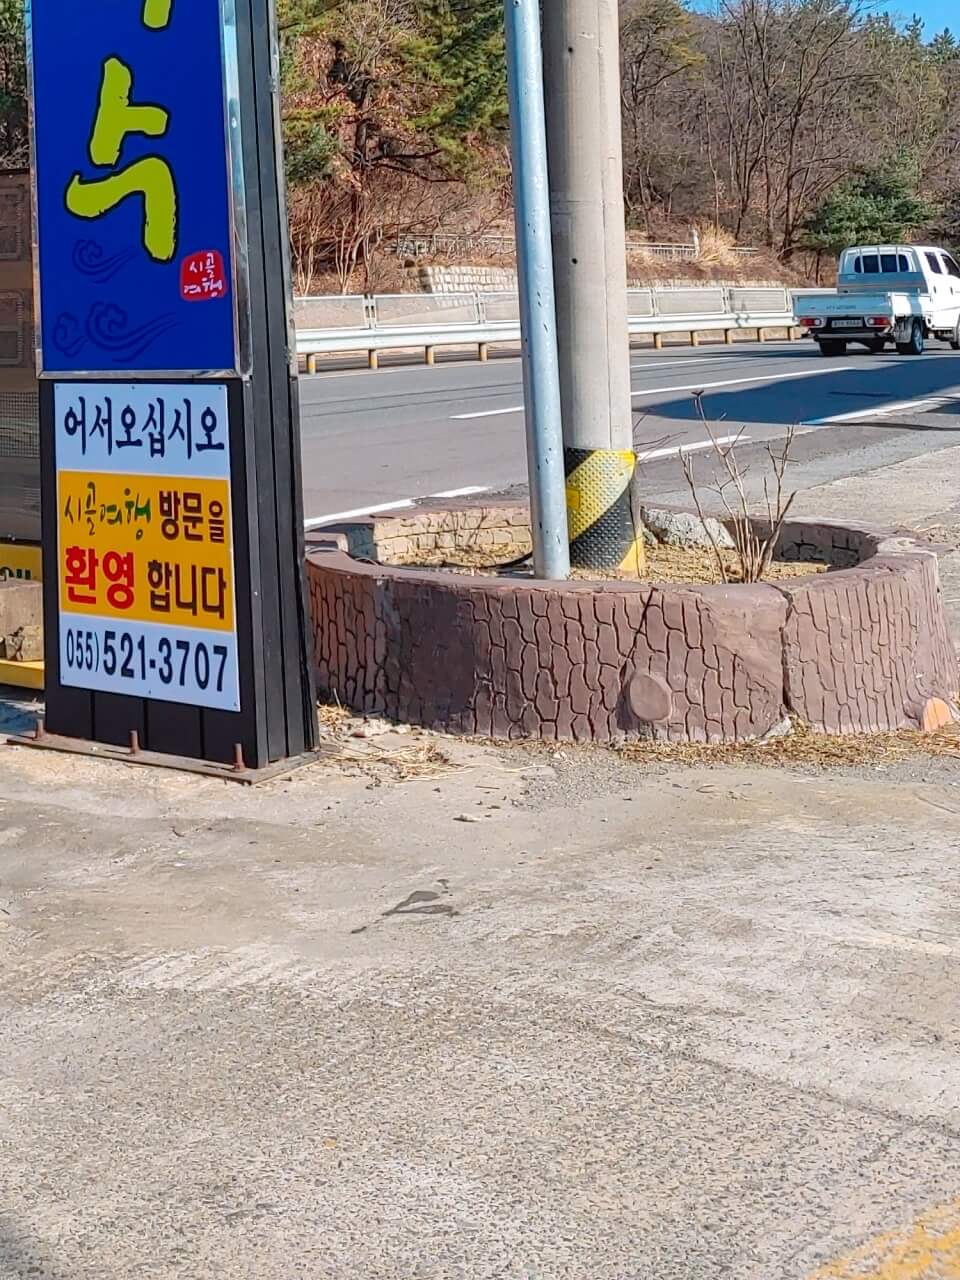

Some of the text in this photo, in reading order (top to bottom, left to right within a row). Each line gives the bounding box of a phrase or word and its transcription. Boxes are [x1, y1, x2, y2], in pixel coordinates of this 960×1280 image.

[63, 395, 225, 460] 어서오십시오
[64, 481, 225, 544] 시골여행 방문을
[64, 545, 228, 621] 환영 합니다
